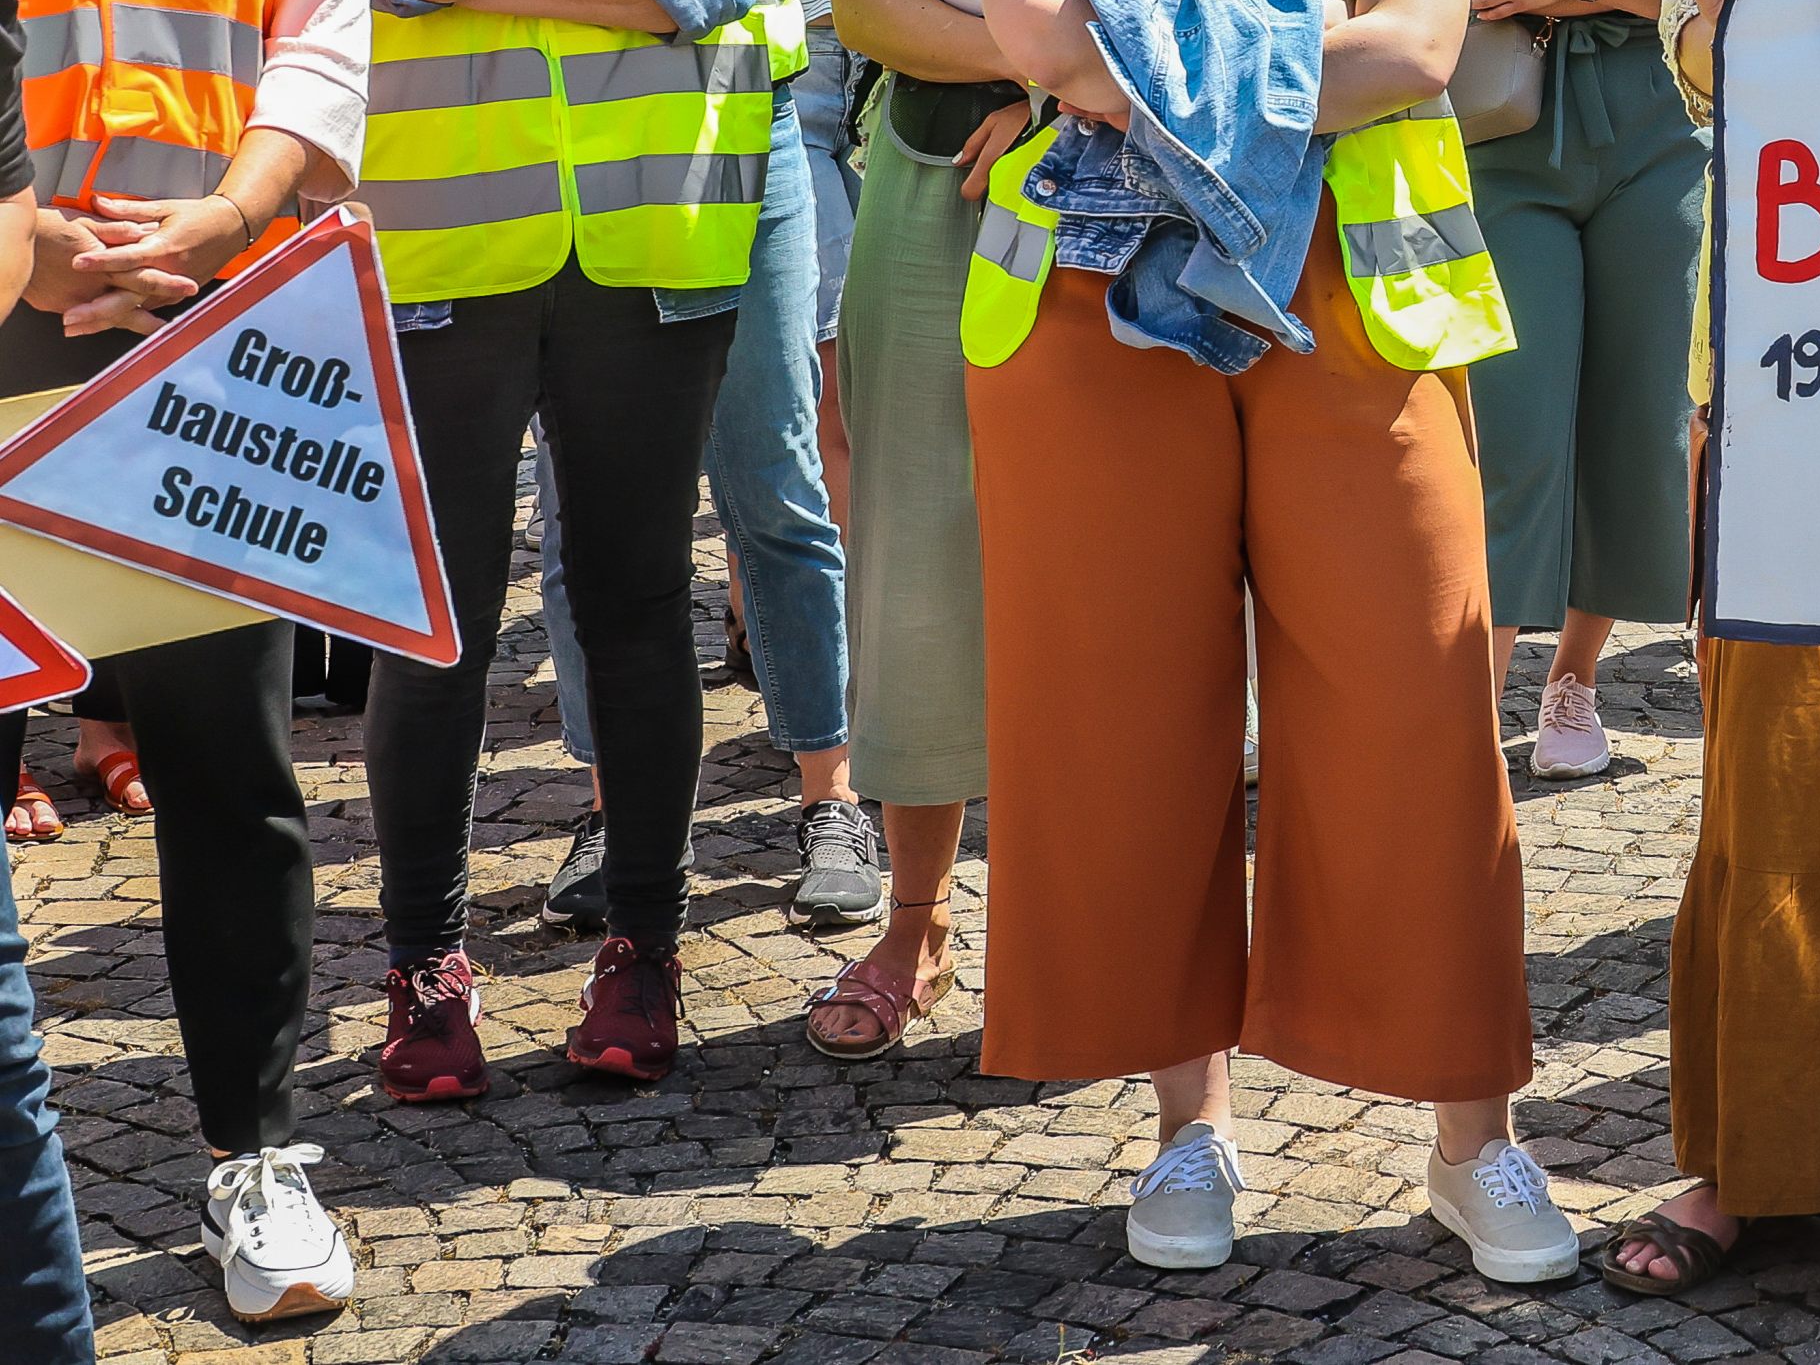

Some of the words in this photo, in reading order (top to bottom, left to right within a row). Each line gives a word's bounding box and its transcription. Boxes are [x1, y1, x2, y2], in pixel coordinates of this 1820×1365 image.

[226, 327, 364, 409] Groß-
[147, 382, 386, 503] baustelle
[153, 465, 329, 565] Schule
